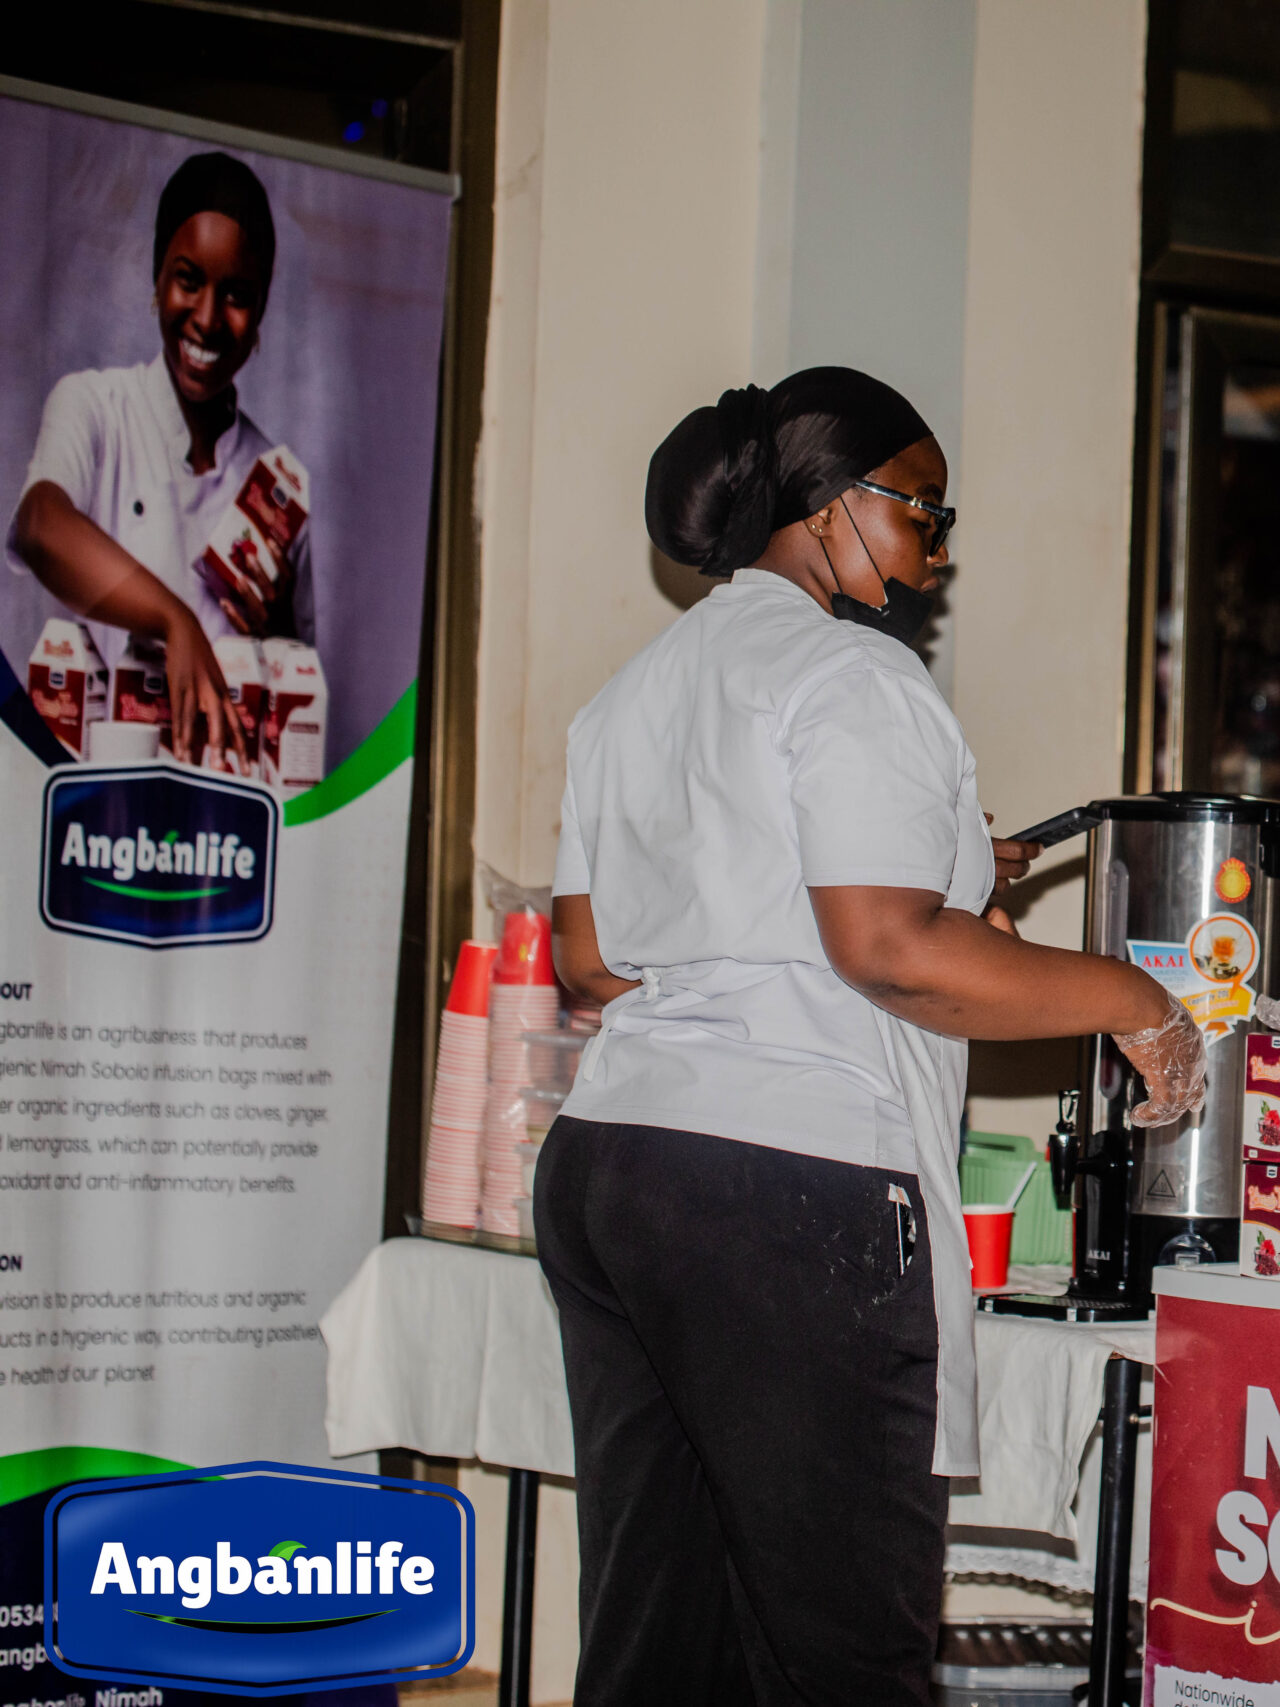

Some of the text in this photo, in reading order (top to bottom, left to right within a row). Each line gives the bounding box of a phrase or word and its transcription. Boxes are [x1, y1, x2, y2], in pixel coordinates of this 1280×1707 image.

[61, 822, 255, 880] Angbanlife
[1142, 955, 1184, 968] AKAI
[0, 983, 32, 1000] OUT
[72, 1026, 92, 1041] an
[98, 1025, 197, 1048] agribusiness
[203, 1030, 236, 1047] that
[241, 1033, 308, 1051] produces
[219, 1066, 257, 1089] bags
[18, 1097, 67, 1120] organic
[73, 1098, 161, 1121] ingredients
[165, 1101, 204, 1119] such
[210, 1104, 230, 1120] as
[98, 1135, 147, 1154] which
[151, 1138, 177, 1154] can
[183, 1138, 266, 1161] potentially
[0, 1171, 51, 1190] oxidant
[54, 1173, 81, 1190] and
[0, 1254, 22, 1271] ON
[71, 1291, 141, 1313] produce
[146, 1288, 218, 1308] nutritious
[223, 1291, 252, 1308] and
[257, 1289, 306, 1312] organic
[62, 1327, 130, 1351] hygienic
[168, 1326, 263, 1348] contributing
[1175, 1680, 1254, 1707] Nationwide
